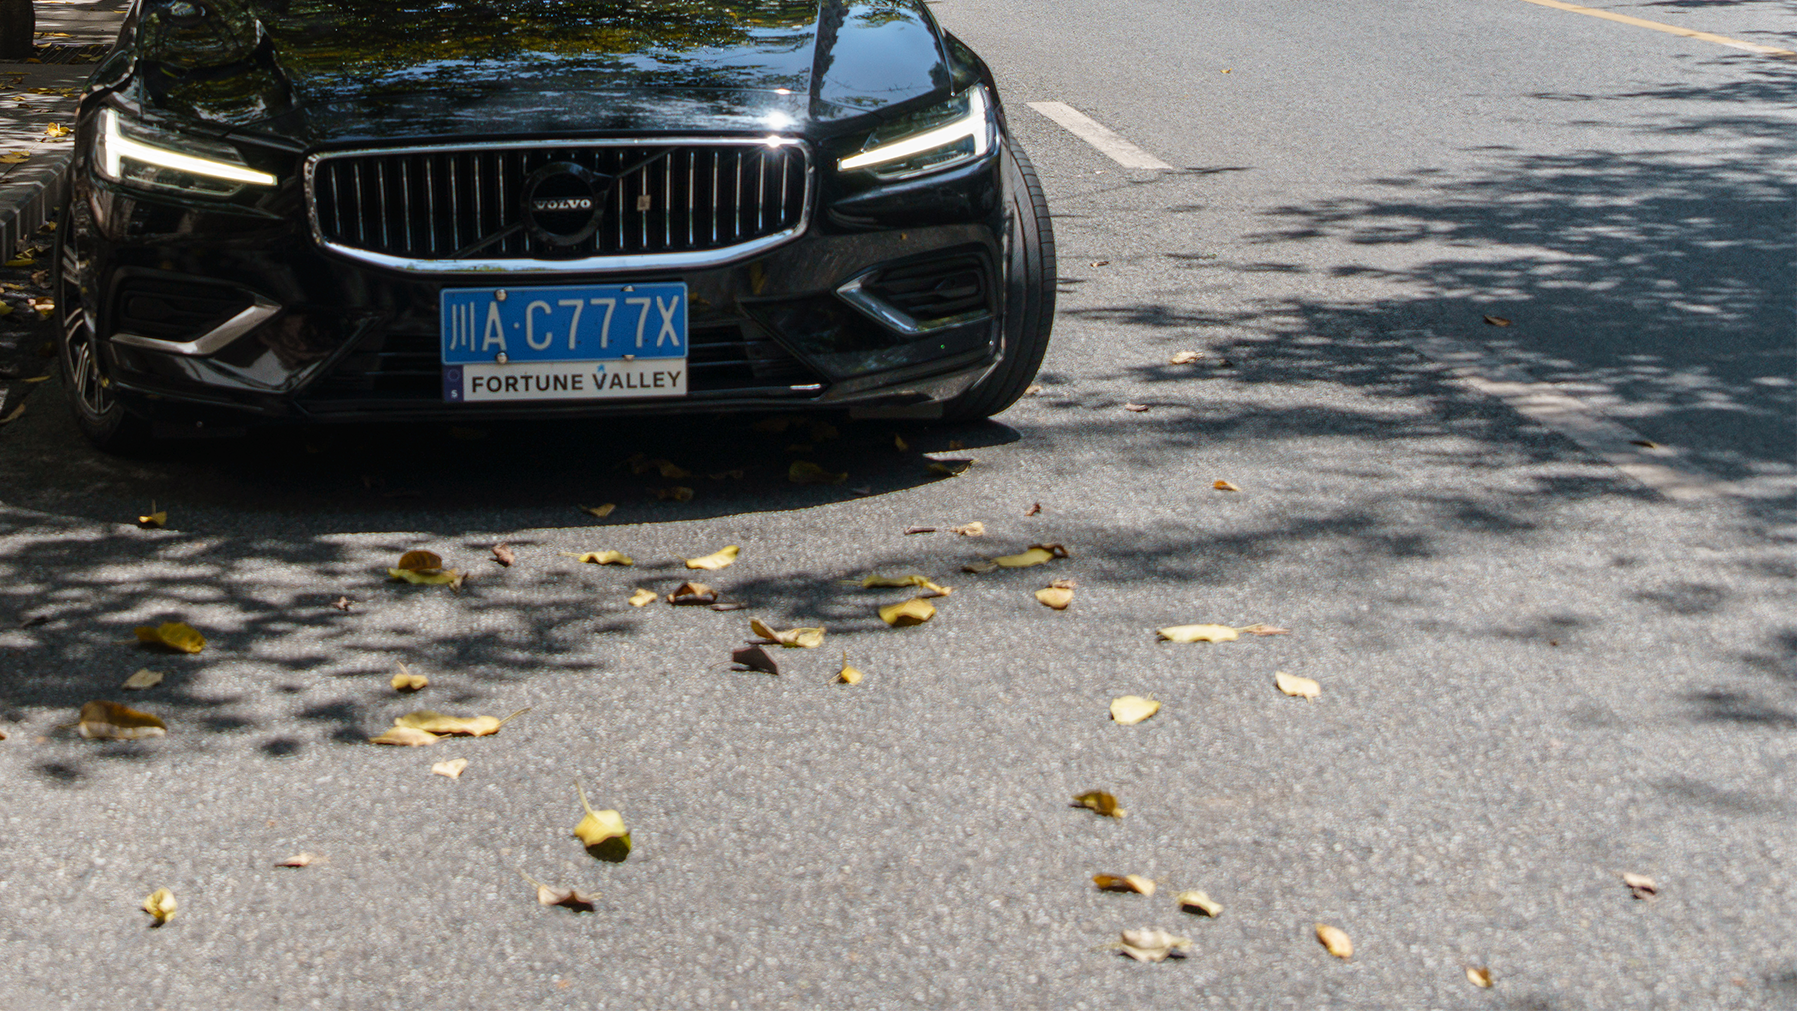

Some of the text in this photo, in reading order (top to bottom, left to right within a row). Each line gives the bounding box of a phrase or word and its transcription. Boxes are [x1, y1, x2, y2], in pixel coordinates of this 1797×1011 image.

[534, 199, 591, 209] VOLVO
[472, 371, 681, 393] FORTUNE VALLEY
